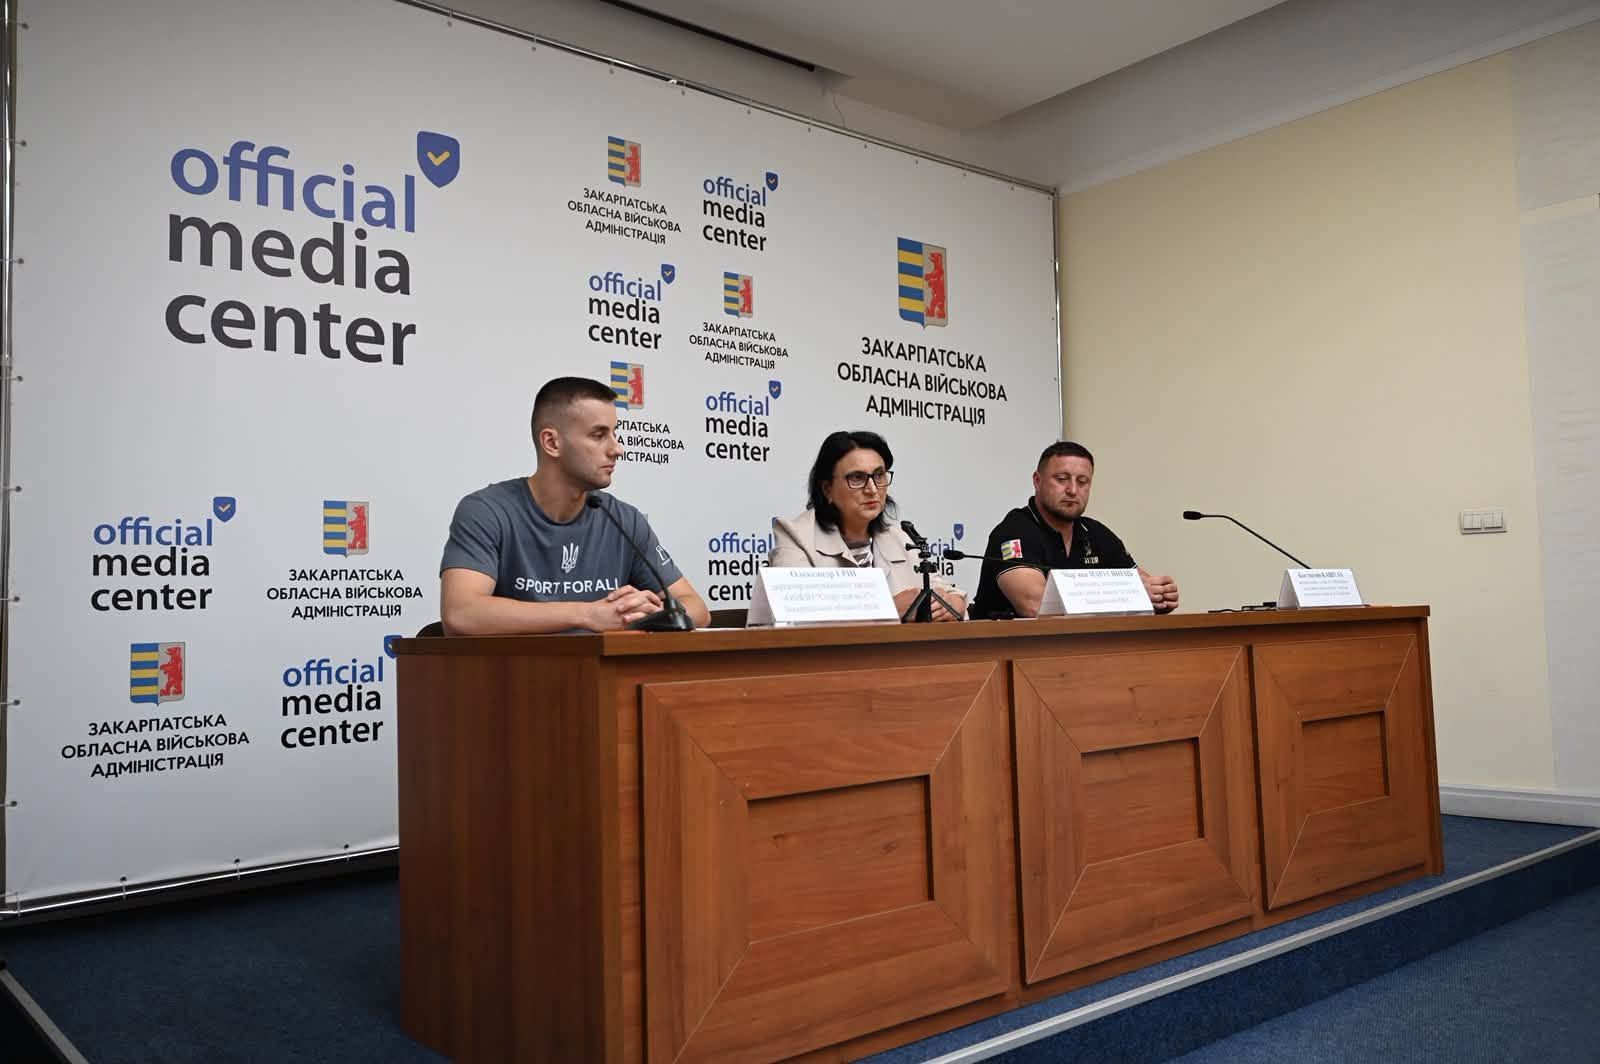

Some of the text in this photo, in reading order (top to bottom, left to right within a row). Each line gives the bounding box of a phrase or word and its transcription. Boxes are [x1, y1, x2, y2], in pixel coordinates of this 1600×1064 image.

[170, 141, 415, 233] official
[703, 176, 766, 206] official
[583, 188, 667, 215] ЗАКАРПАТСЬКА
[703, 199, 765, 227] media
[567, 200, 681, 233] ОБЛАСНА ВІЙСЬКОВА
[585, 221, 666, 245] АДМІНІСТРАЦІЯ
[703, 224, 767, 251] center
[168, 213, 410, 295] media
[589, 271, 662, 301] official
[588, 297, 660, 324] media
[165, 294, 416, 366] center
[588, 324, 662, 350] center
[702, 322, 776, 342] ЗАКАРПАТСЬКА
[689, 335, 788, 358] ОБЛАСНА ВІЙСЬКОВА
[861, 336, 987, 372] ЗАКАРПАТСЬКА
[705, 353, 775, 370] АДМІНІСТРАЦІЯ
[837, 362, 1008, 401] ОБЛАСНА ВІЙСЬКОВА
[705, 391, 769, 416] official
[865, 394, 986, 427] АДМІНІСТРАЦІЯ
[616, 420, 671, 434] РПАТСЬКА
[705, 415, 768, 438] media
[627, 435, 685, 450] ВІЙСЬКОВА
[705, 441, 770, 462] center
[93, 516, 213, 546] official
[708, 532, 772, 553] official
[92, 547, 210, 577] media
[288, 569, 404, 582] ЗАКАРПАТСЬКА
[91, 584, 212, 611] center
[266, 586, 423, 601] ОБЛАСНА ВІЙСЬКОВА
[514, 577, 561, 594] SPORT
[563, 581, 593, 594] FOR
[708, 582, 753, 601] cent
[291, 604, 402, 620] АДМІНІСТРАЦІЯ
[282, 657, 384, 687] official
[281, 684, 382, 717] media
[88, 714, 227, 737] ЗАКАРПАТСЬКА
[280, 720, 384, 749] center
[61, 732, 250, 759] ОБЛАСНА ВІЙСЬКОВА
[91, 753, 224, 779] АДМІНІСТРАЦІЯ
